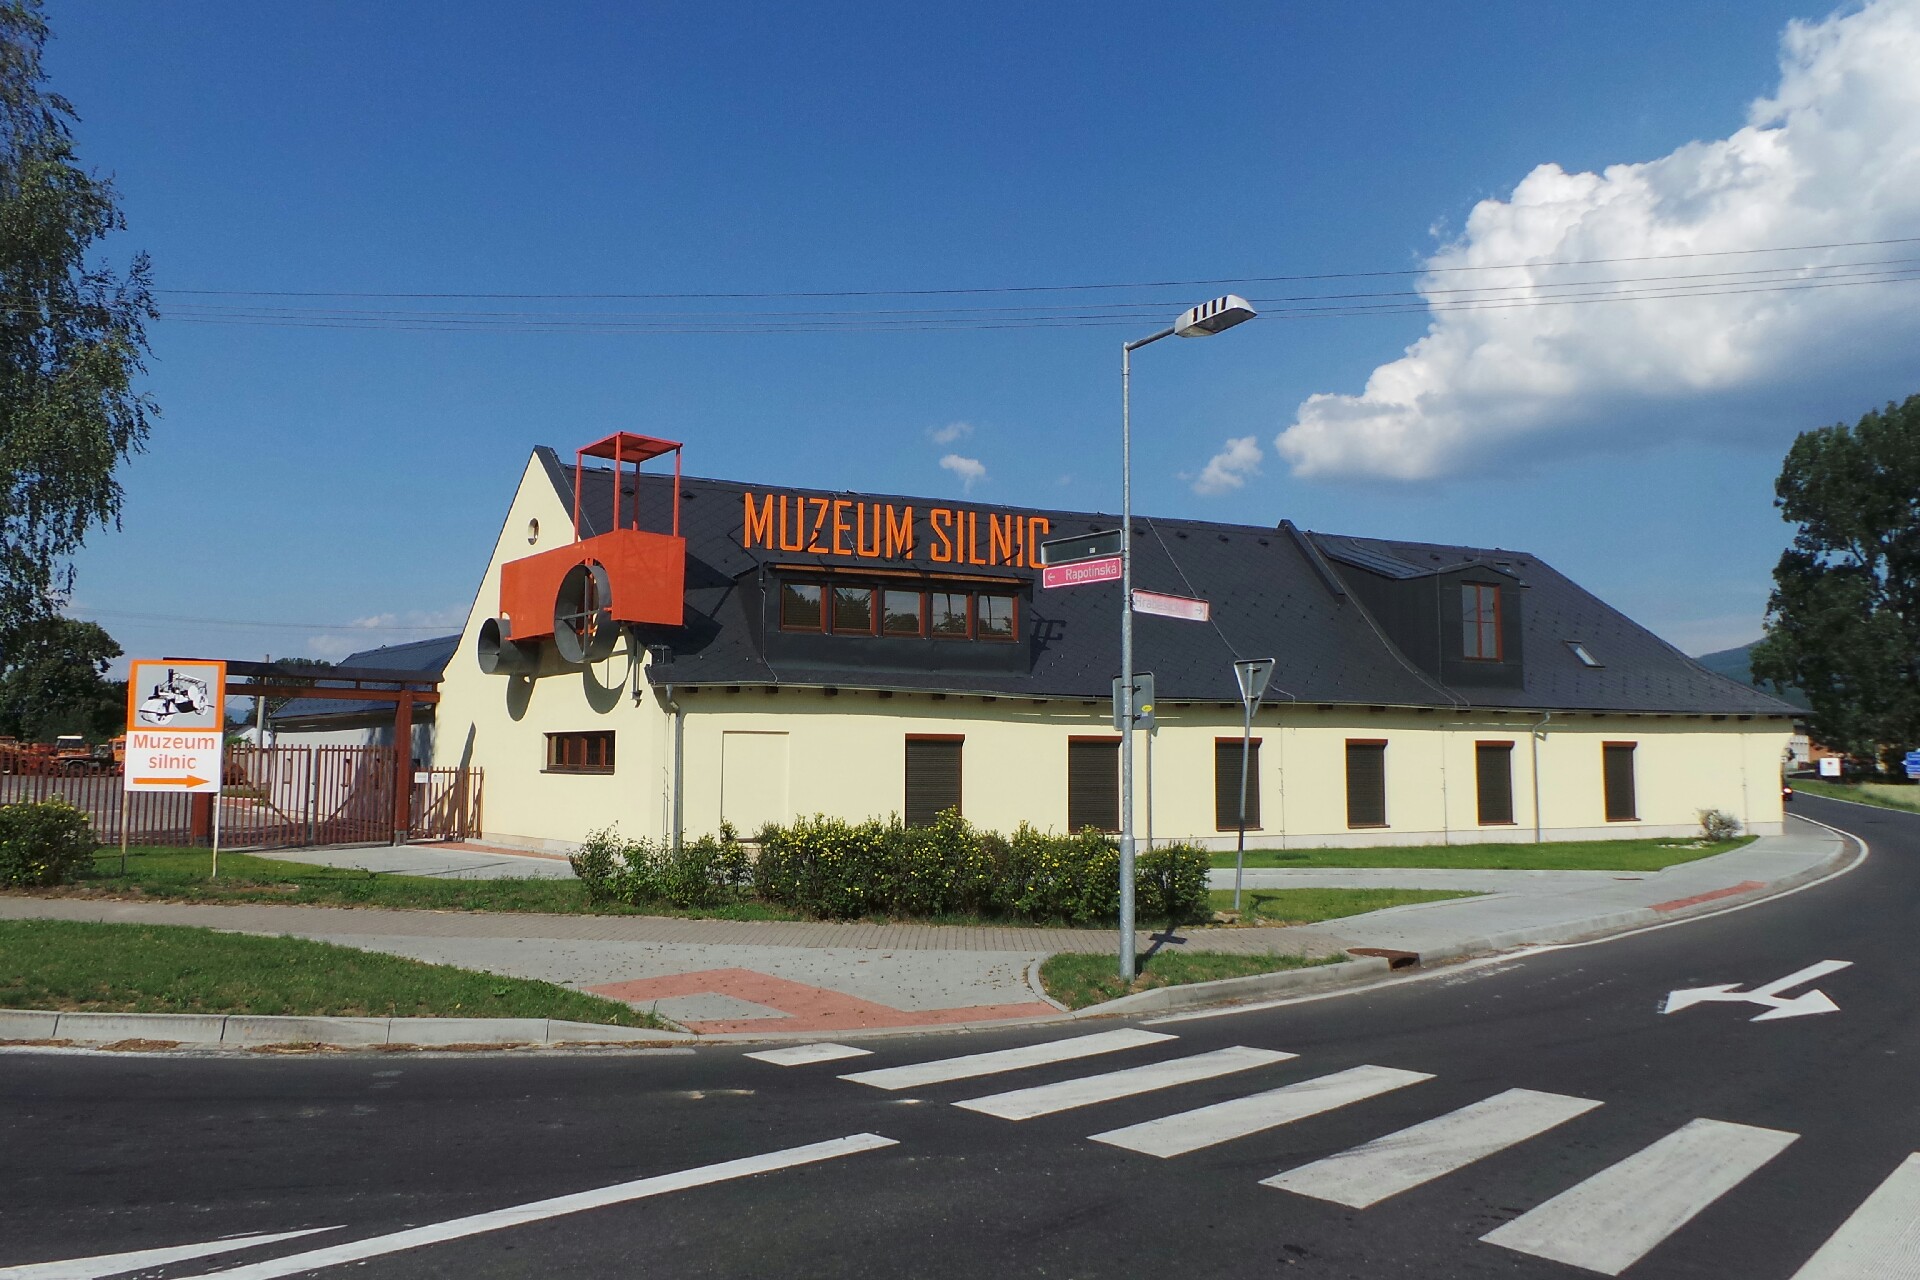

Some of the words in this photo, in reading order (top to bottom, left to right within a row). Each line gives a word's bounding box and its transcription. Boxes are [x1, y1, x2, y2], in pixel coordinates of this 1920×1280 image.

[744, 492, 913, 560] MUZEUM
[930, 508, 1049, 569] SILNIC
[1065, 562, 1117, 582] Rapotínská
[133, 734, 215, 750] Muzeum
[149, 754, 197, 769] silnic
